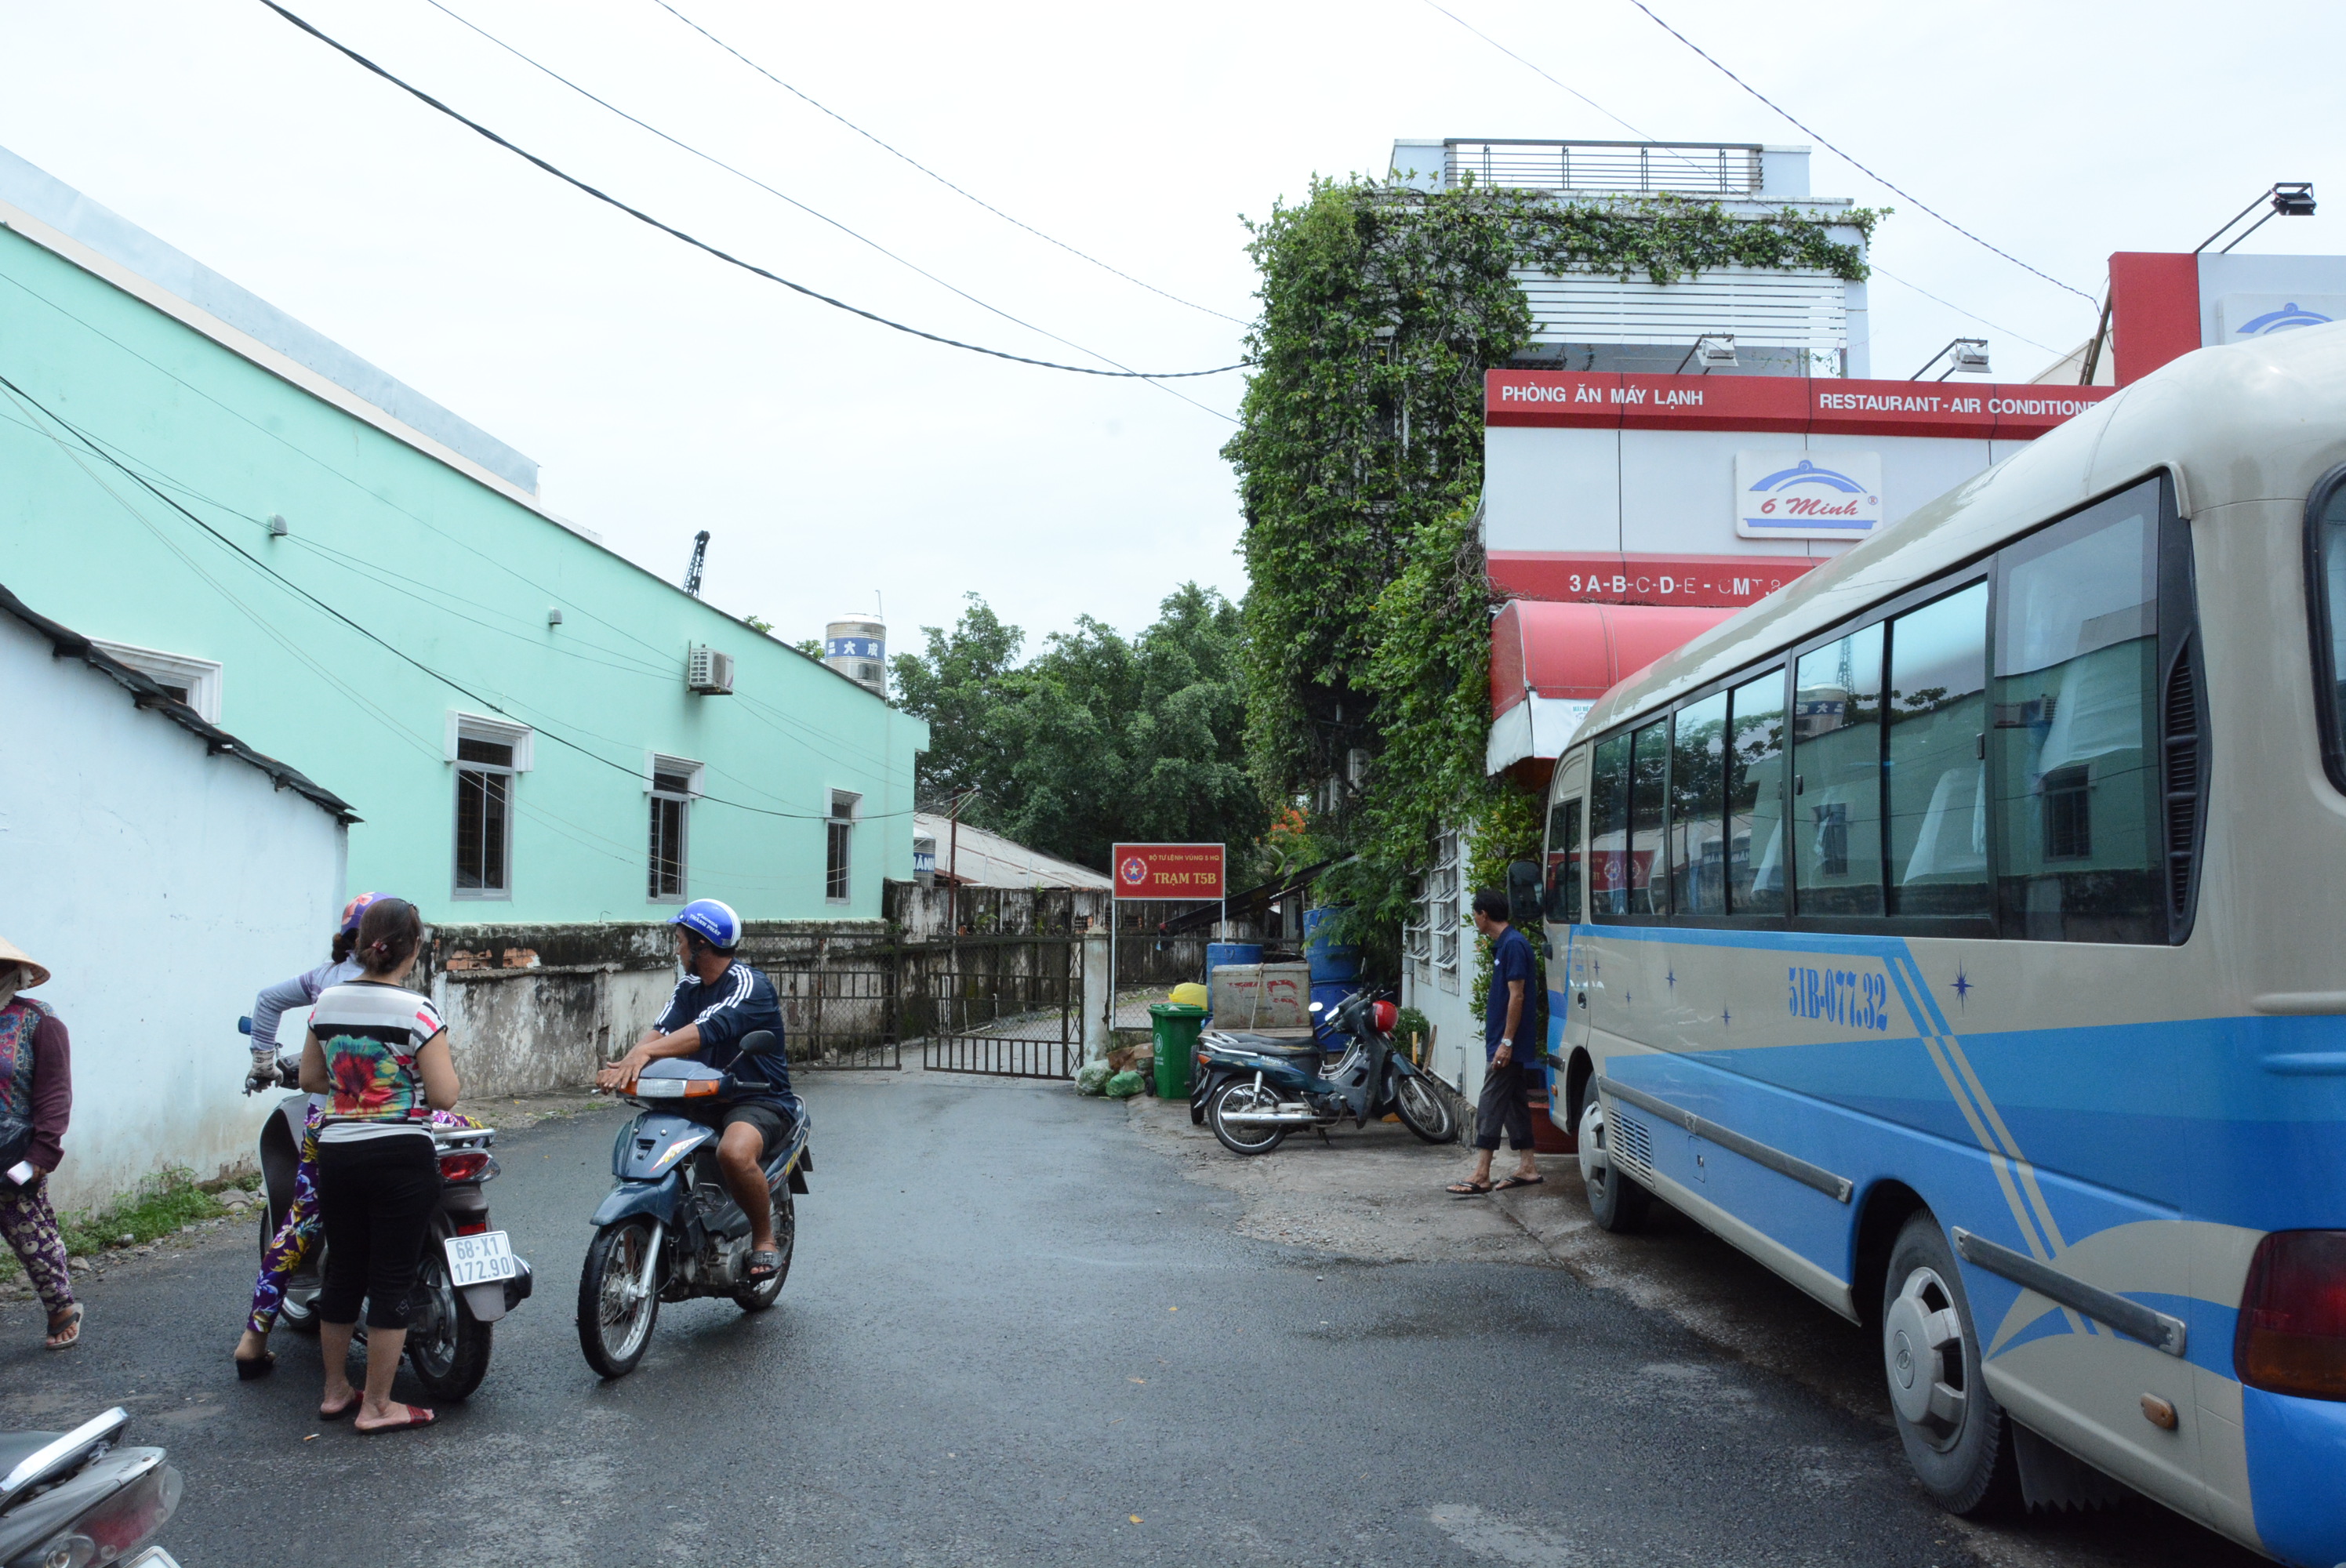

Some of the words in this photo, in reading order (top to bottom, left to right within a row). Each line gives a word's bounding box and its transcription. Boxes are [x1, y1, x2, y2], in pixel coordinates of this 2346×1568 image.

[1502, 382, 1567, 402] PHÒNG
[1574, 383, 1602, 403] ĂN
[1611, 384, 1647, 405] MÁY
[1654, 390, 1703, 409] LẠNH
[1988, 398, 2098, 416] CONDITION
[1760, 498, 1778, 514] 6
[1785, 497, 1858, 516] Minh
[1153, 873, 1189, 886] TRẠM
[1193, 873, 1217, 884] T5B
[701, 915, 718, 928] HONDA
[1788, 967, 1888, 1031] 51B-077.32
[455, 1257, 510, 1282] 172.90
